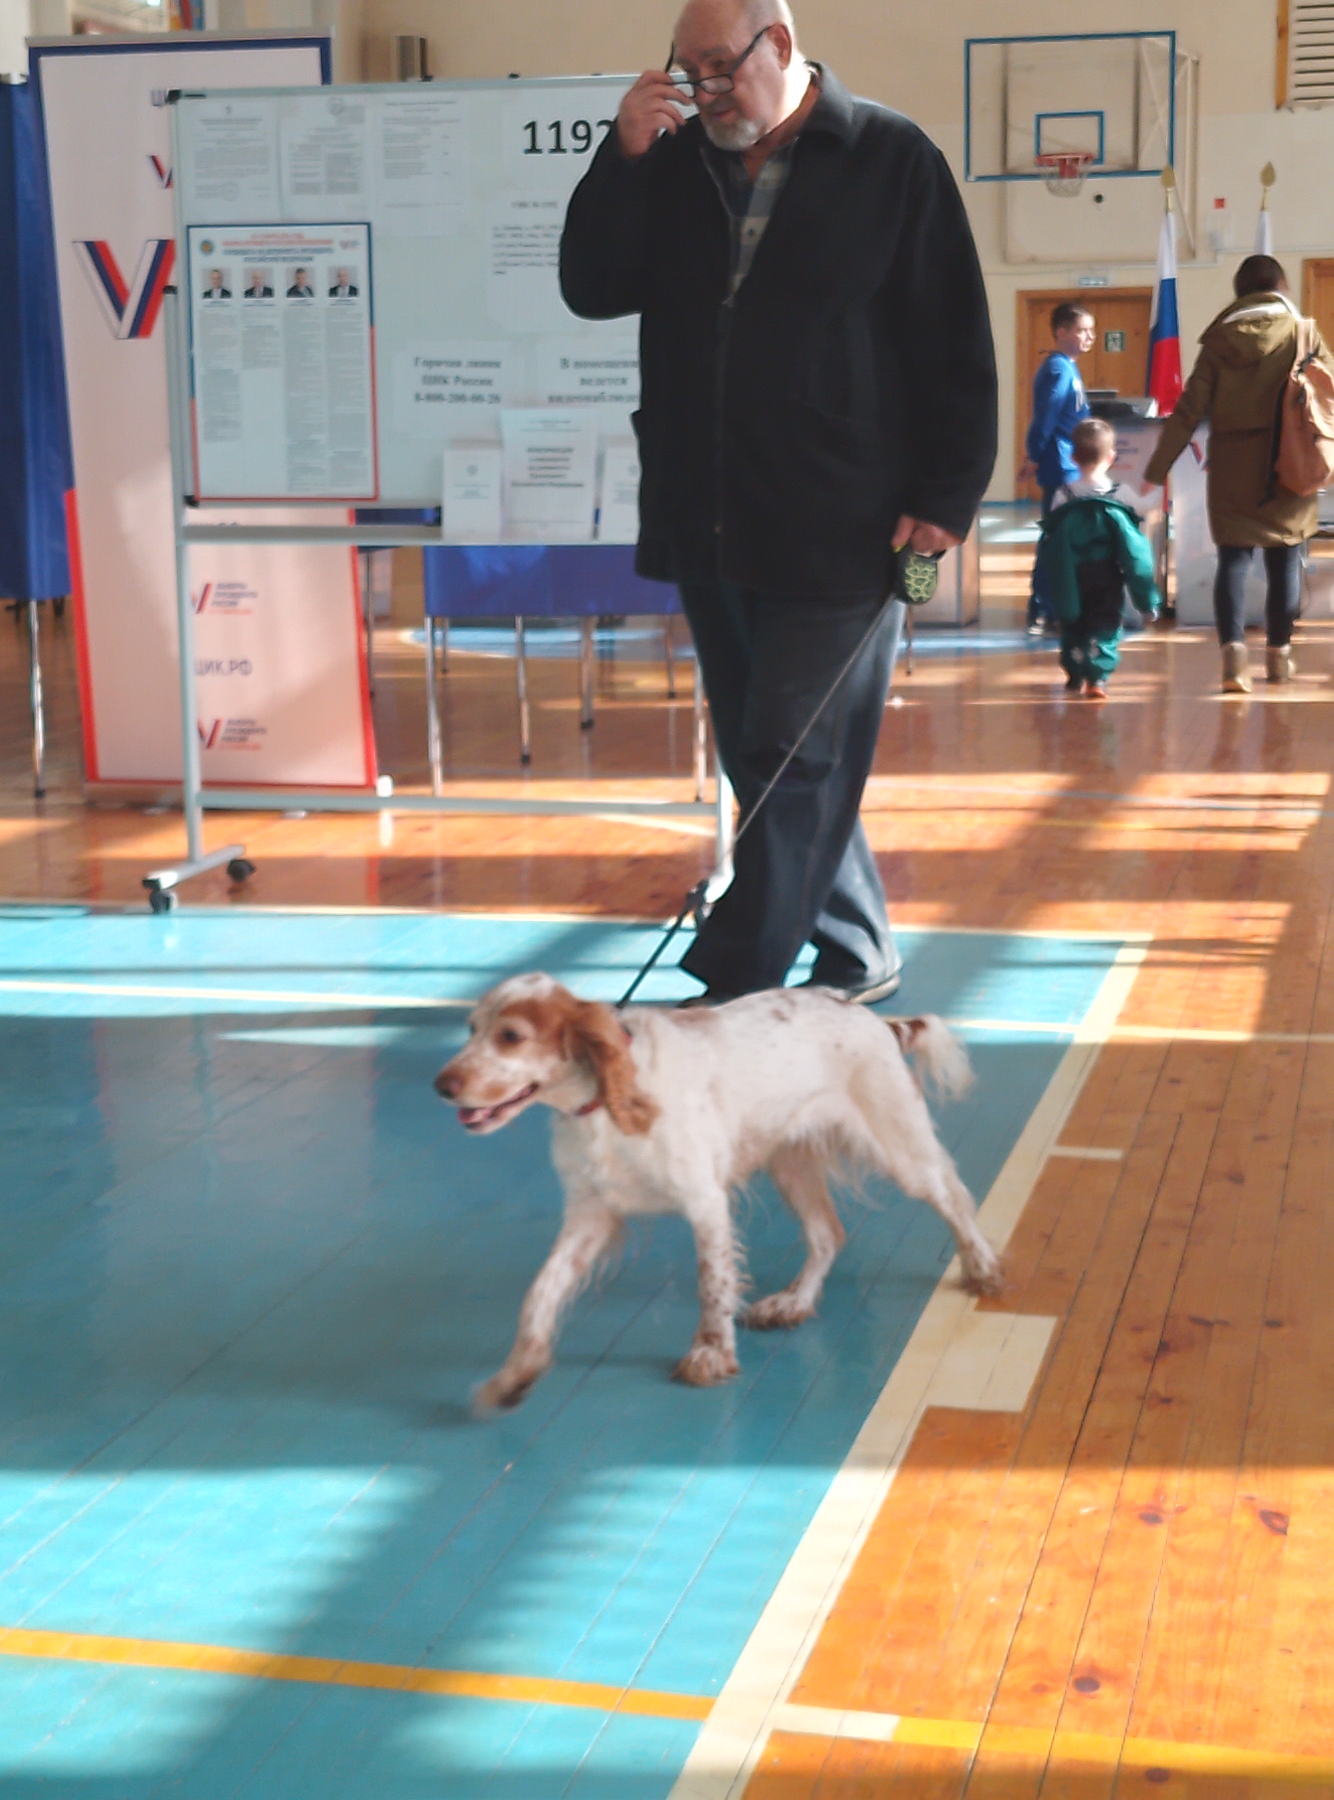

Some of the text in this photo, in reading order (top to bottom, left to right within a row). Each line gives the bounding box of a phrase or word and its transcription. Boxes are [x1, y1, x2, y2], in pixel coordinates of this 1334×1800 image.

[413, 356, 501, 370] Горячая линия
[559, 357, 570, 369] В
[453, 374, 494, 386] России
[195, 659, 253, 677] ЦИК.РФ
